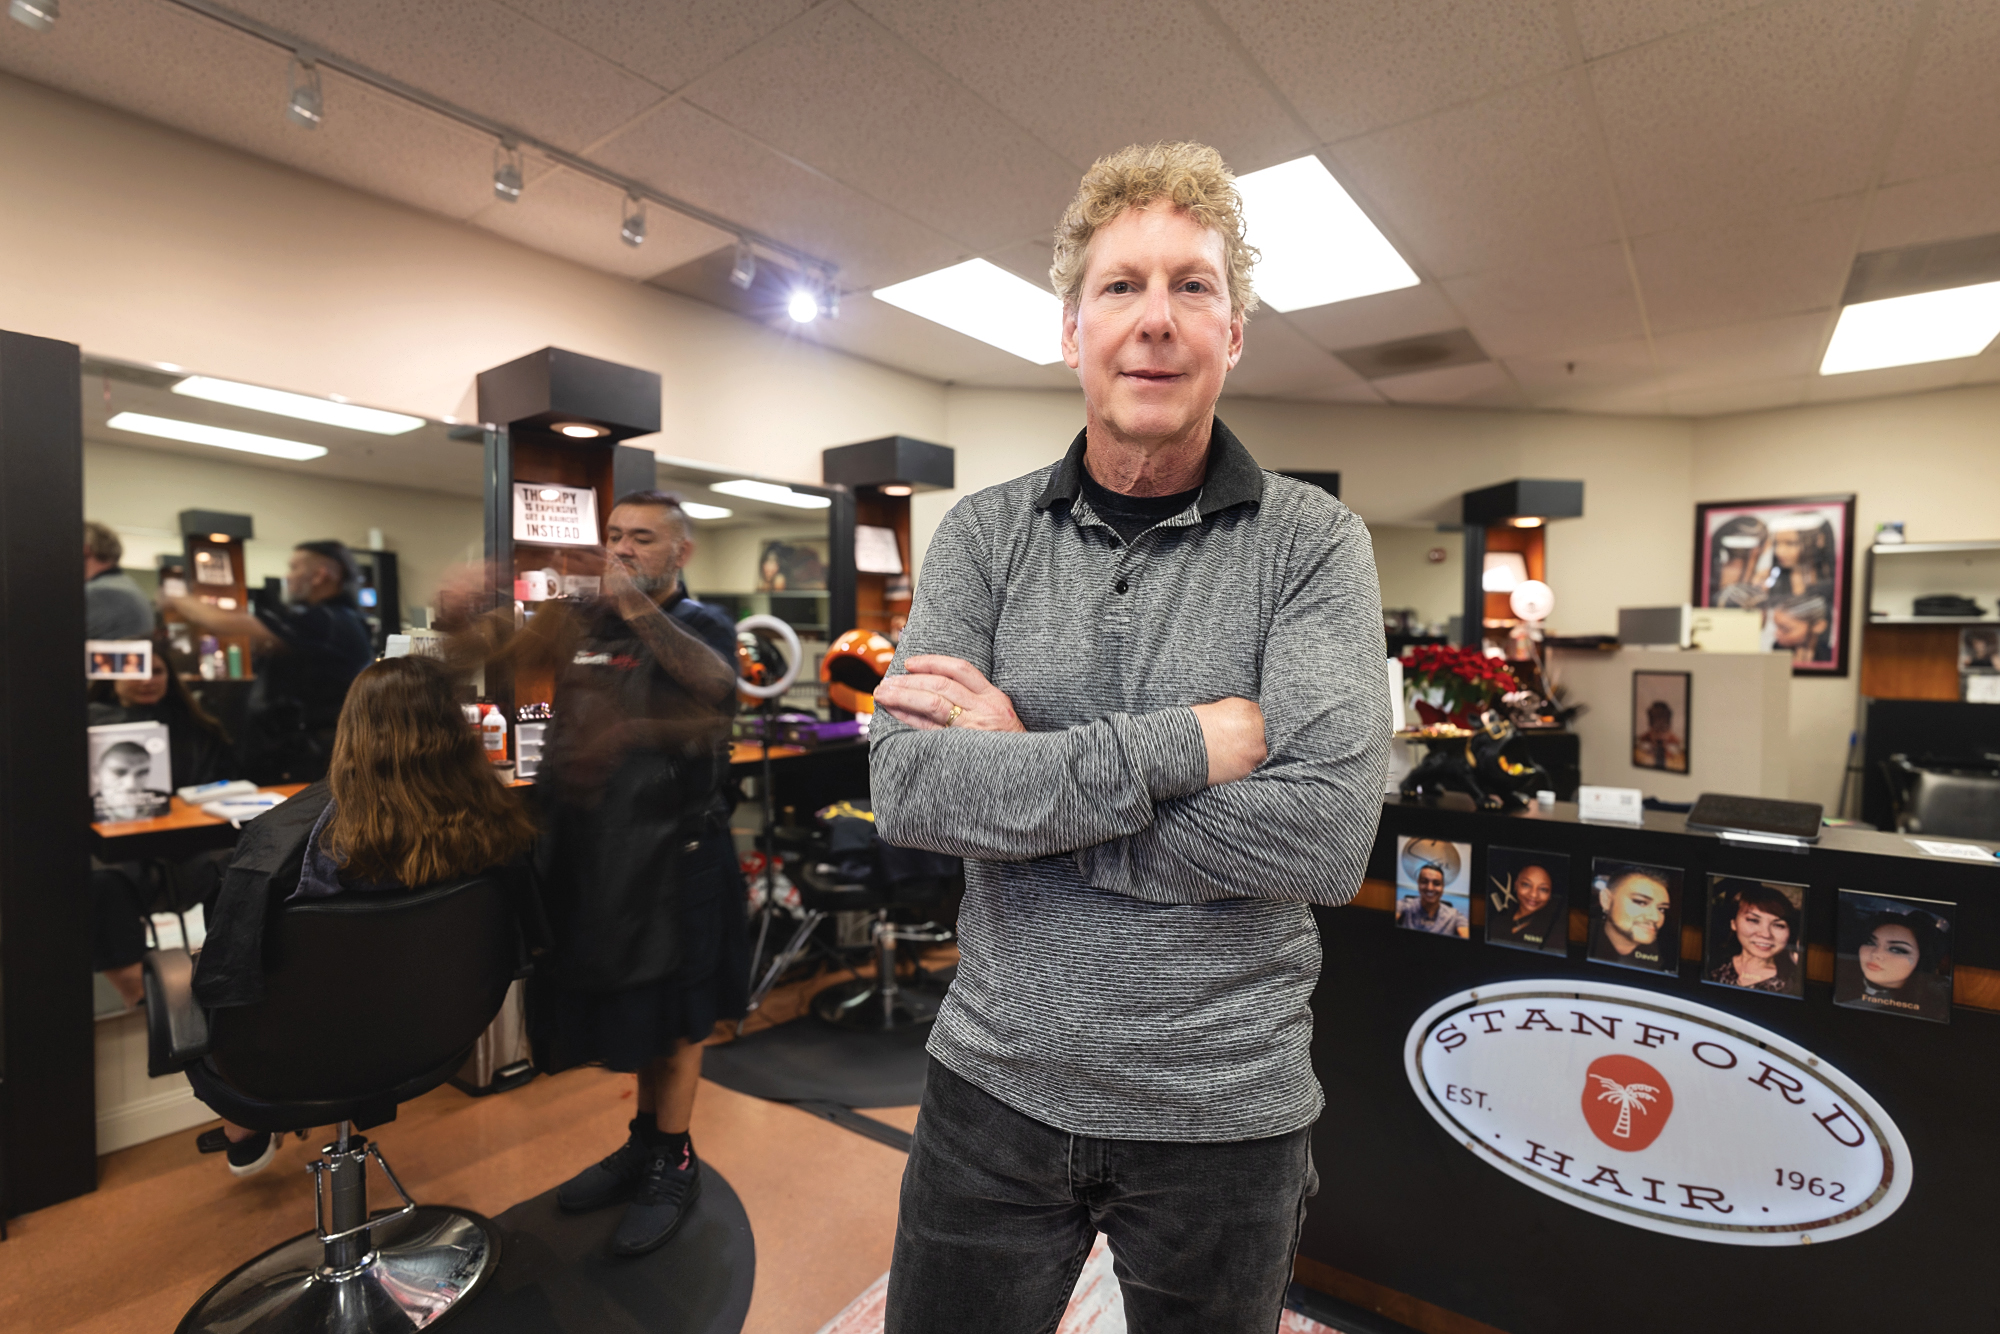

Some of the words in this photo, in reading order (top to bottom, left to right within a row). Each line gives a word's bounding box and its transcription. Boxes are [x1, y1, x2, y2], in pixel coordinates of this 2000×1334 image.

[523, 488, 576, 504] THPY
[535, 505, 577, 515] EXPENSIVE
[527, 524, 580, 539] INSTEAD
[1634, 951, 1659, 962] David
[1861, 993, 1920, 1011] Franchesca
[1435, 1007, 1866, 1149] STANFORD
[1446, 1083, 1492, 1112] EST.
[1775, 1167, 1846, 1203] 1962
